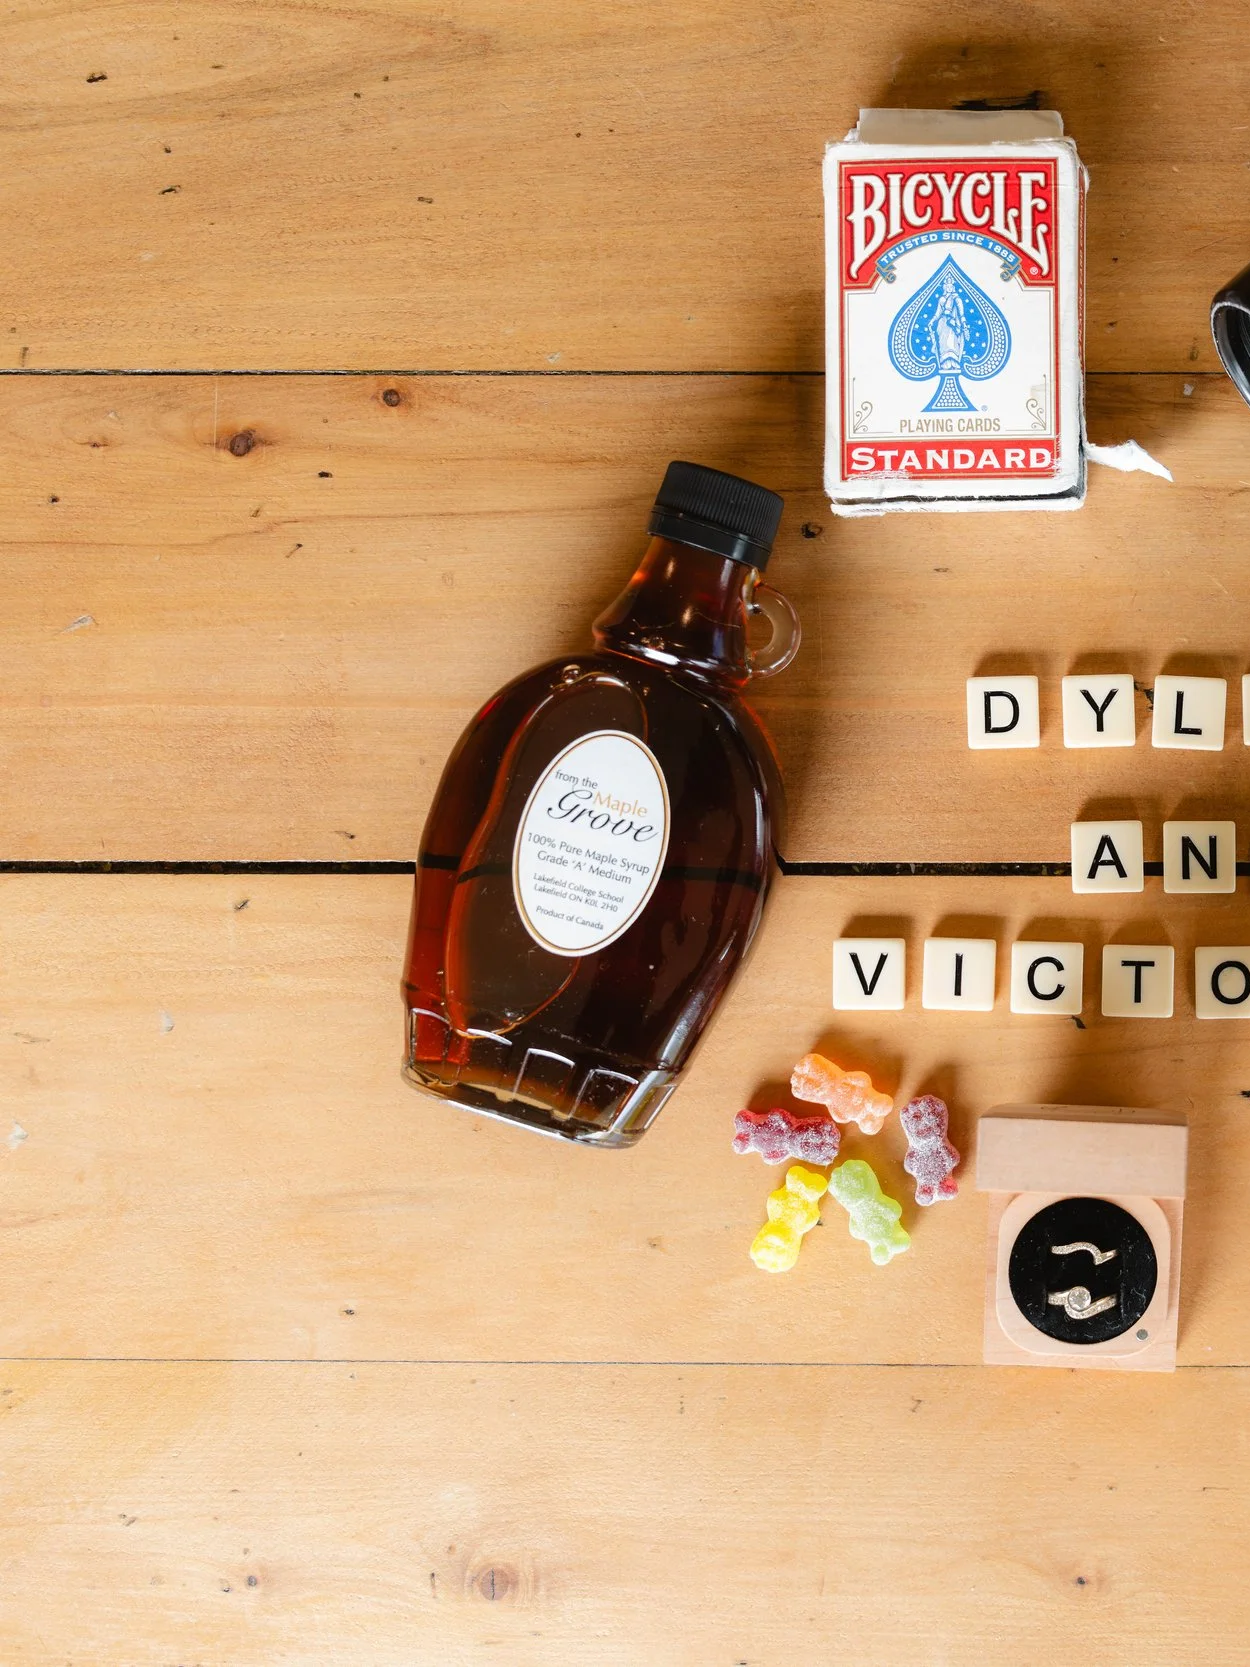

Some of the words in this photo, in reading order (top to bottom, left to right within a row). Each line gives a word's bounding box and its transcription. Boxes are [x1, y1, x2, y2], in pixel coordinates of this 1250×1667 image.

[847, 171, 1050, 279] BICYCLE
[880, 233, 939, 264] TRUSTED
[942, 232, 983, 245] SINCE
[987, 241, 1016, 263] 1885
[899, 418, 953, 433] PLAYING
[957, 417, 1001, 432] CARDS
[851, 447, 1052, 471] STANDARD
[555, 770, 579, 785] from
[582, 777, 598, 790] the
[547, 784, 660, 842] Grove
[592, 791, 648, 818] Maple
[527, 832, 557, 849] 100%
[559, 841, 583, 856] Pure
[585, 849, 618, 866] Maple
[620, 858, 650, 876] Syrup
[537, 850, 569, 867] Grade
[588, 865, 632, 885] Medium
[533, 873, 568, 888] Lakefield
[568, 882, 597, 897] College
[598, 890, 625, 904] School
[534, 883, 568, 899] Lakefield
[568, 893, 583, 903] ON
[536, 905, 565, 920] Product
[566, 914, 575, 922] of
[575, 917, 604, 931] Canada
